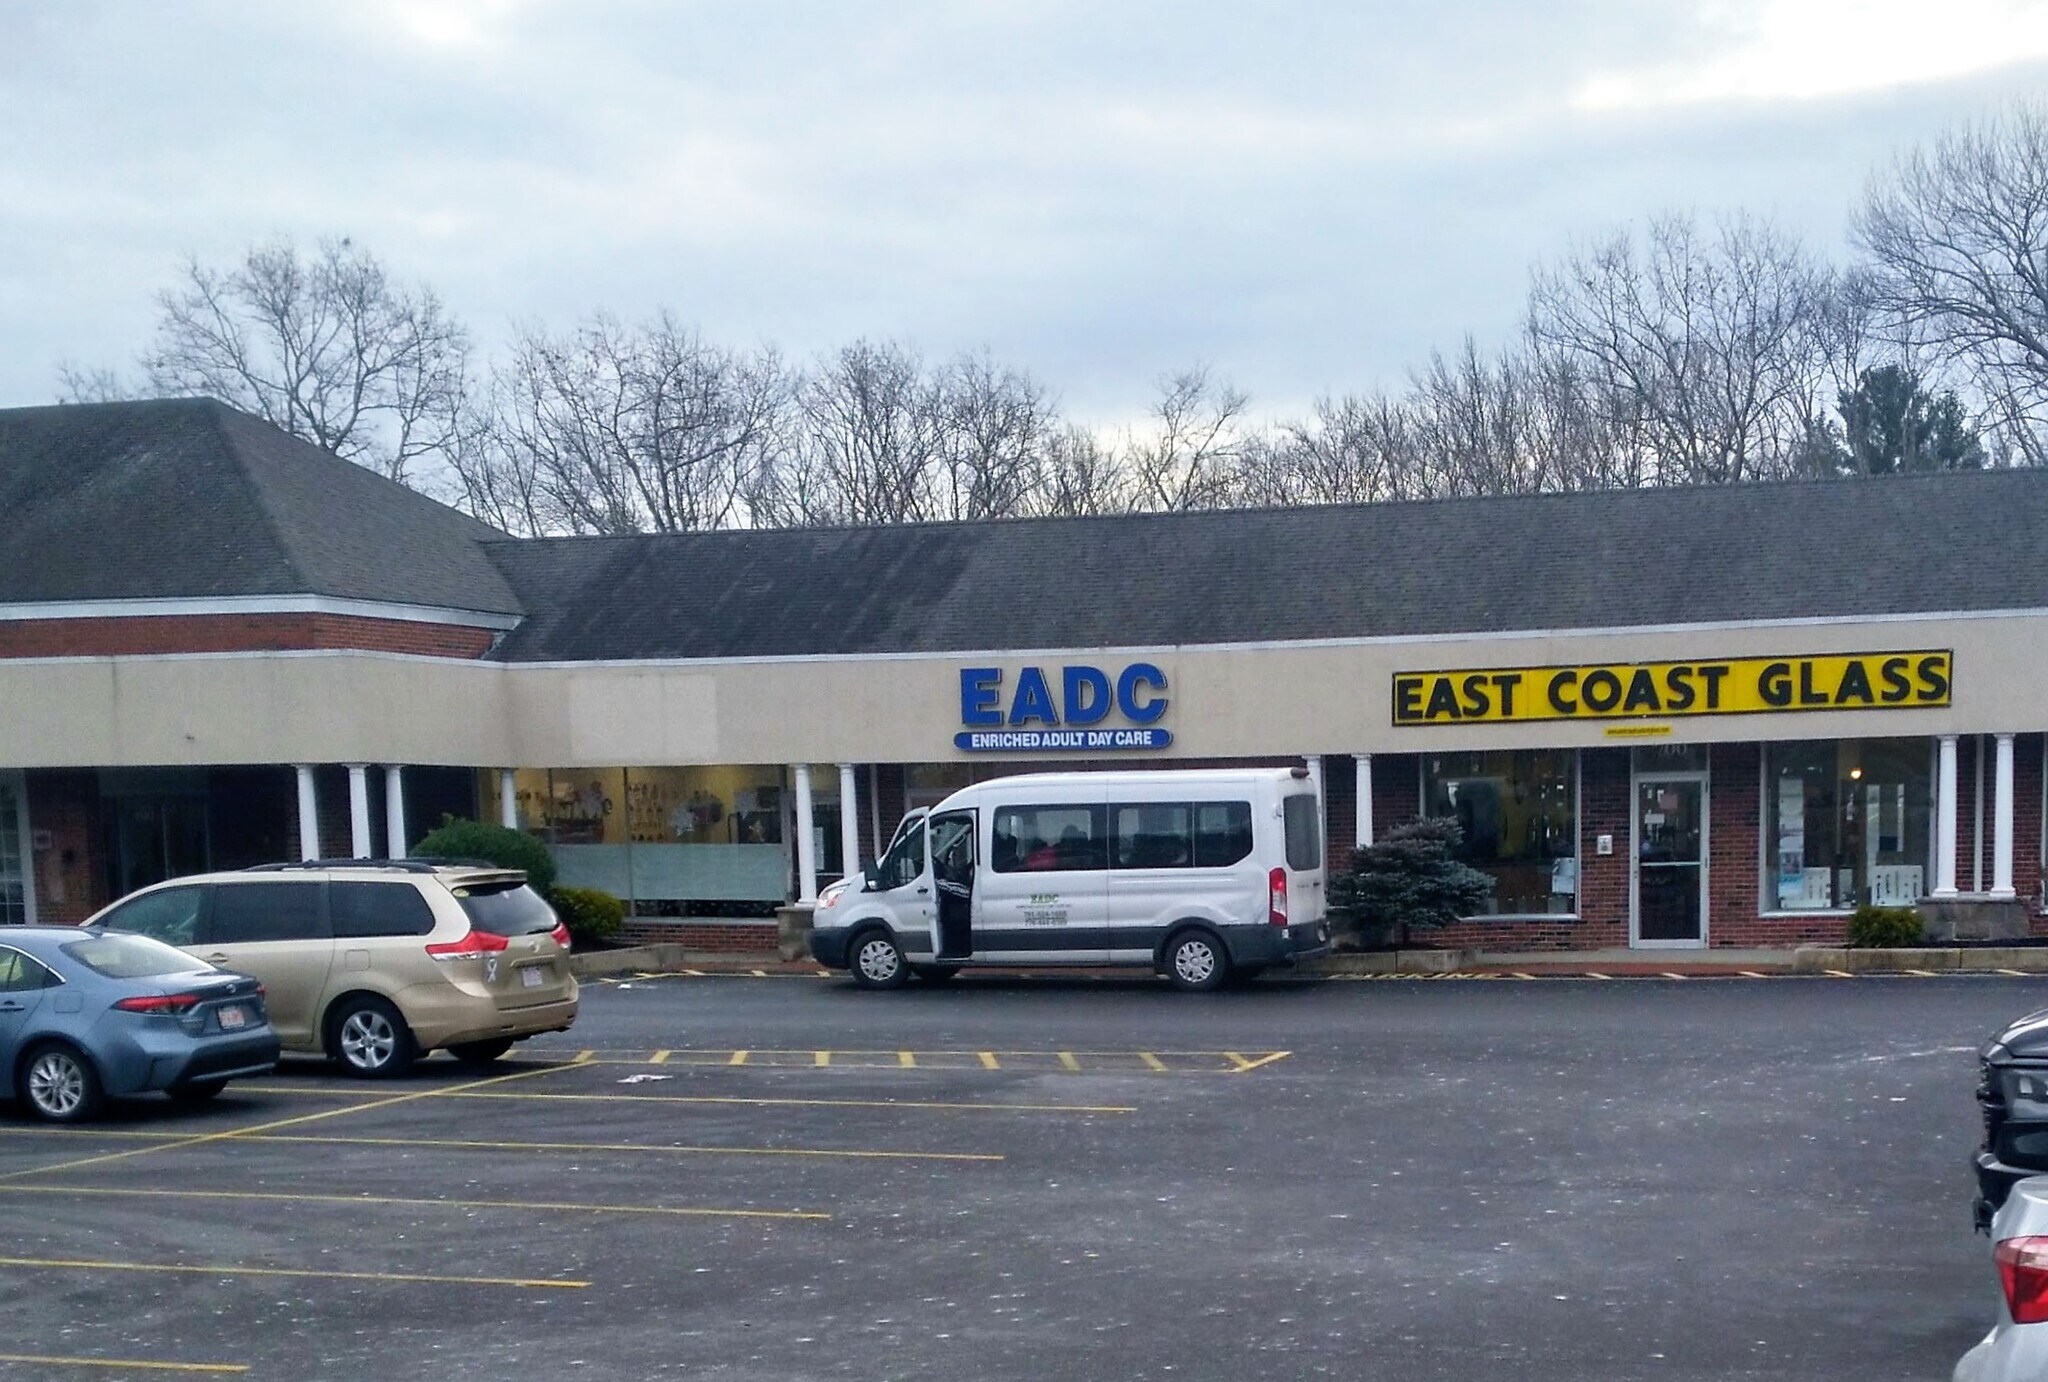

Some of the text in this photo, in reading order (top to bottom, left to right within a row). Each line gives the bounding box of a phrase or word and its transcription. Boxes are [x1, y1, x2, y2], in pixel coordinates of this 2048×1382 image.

[960, 662, 1168, 725] EADC
[1396, 657, 1948, 720] EAST COAST GLASS
[971, 731, 1152, 748] ENRICHED ADULT DAY CARE
[1030, 894, 1059, 903] EADC
